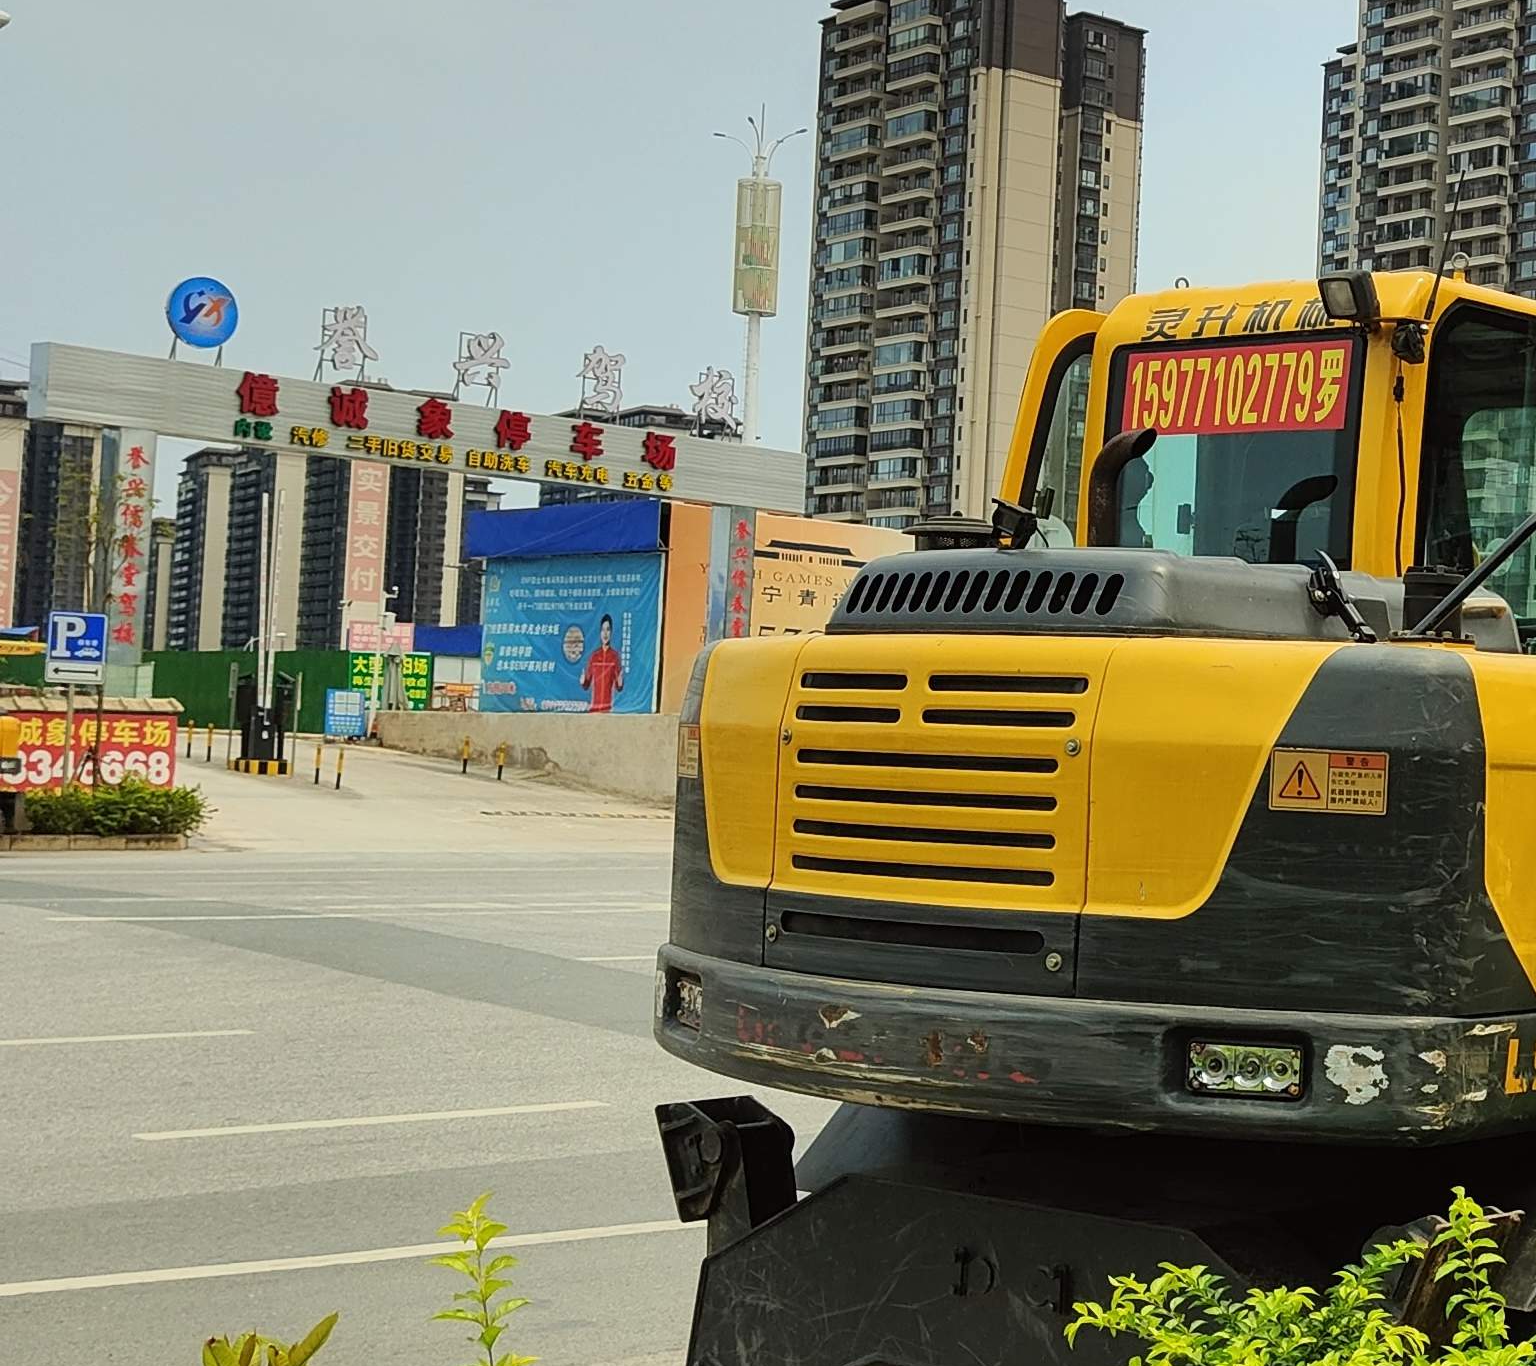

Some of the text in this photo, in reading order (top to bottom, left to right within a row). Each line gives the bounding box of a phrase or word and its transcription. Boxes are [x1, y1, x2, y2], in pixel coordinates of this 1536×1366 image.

[1131, 348, 1345, 429] 15977102779罗
[351, 467, 383, 592] 实景交付
[773, 571, 834, 587] GAMES
[51, 615, 87, 658] P
